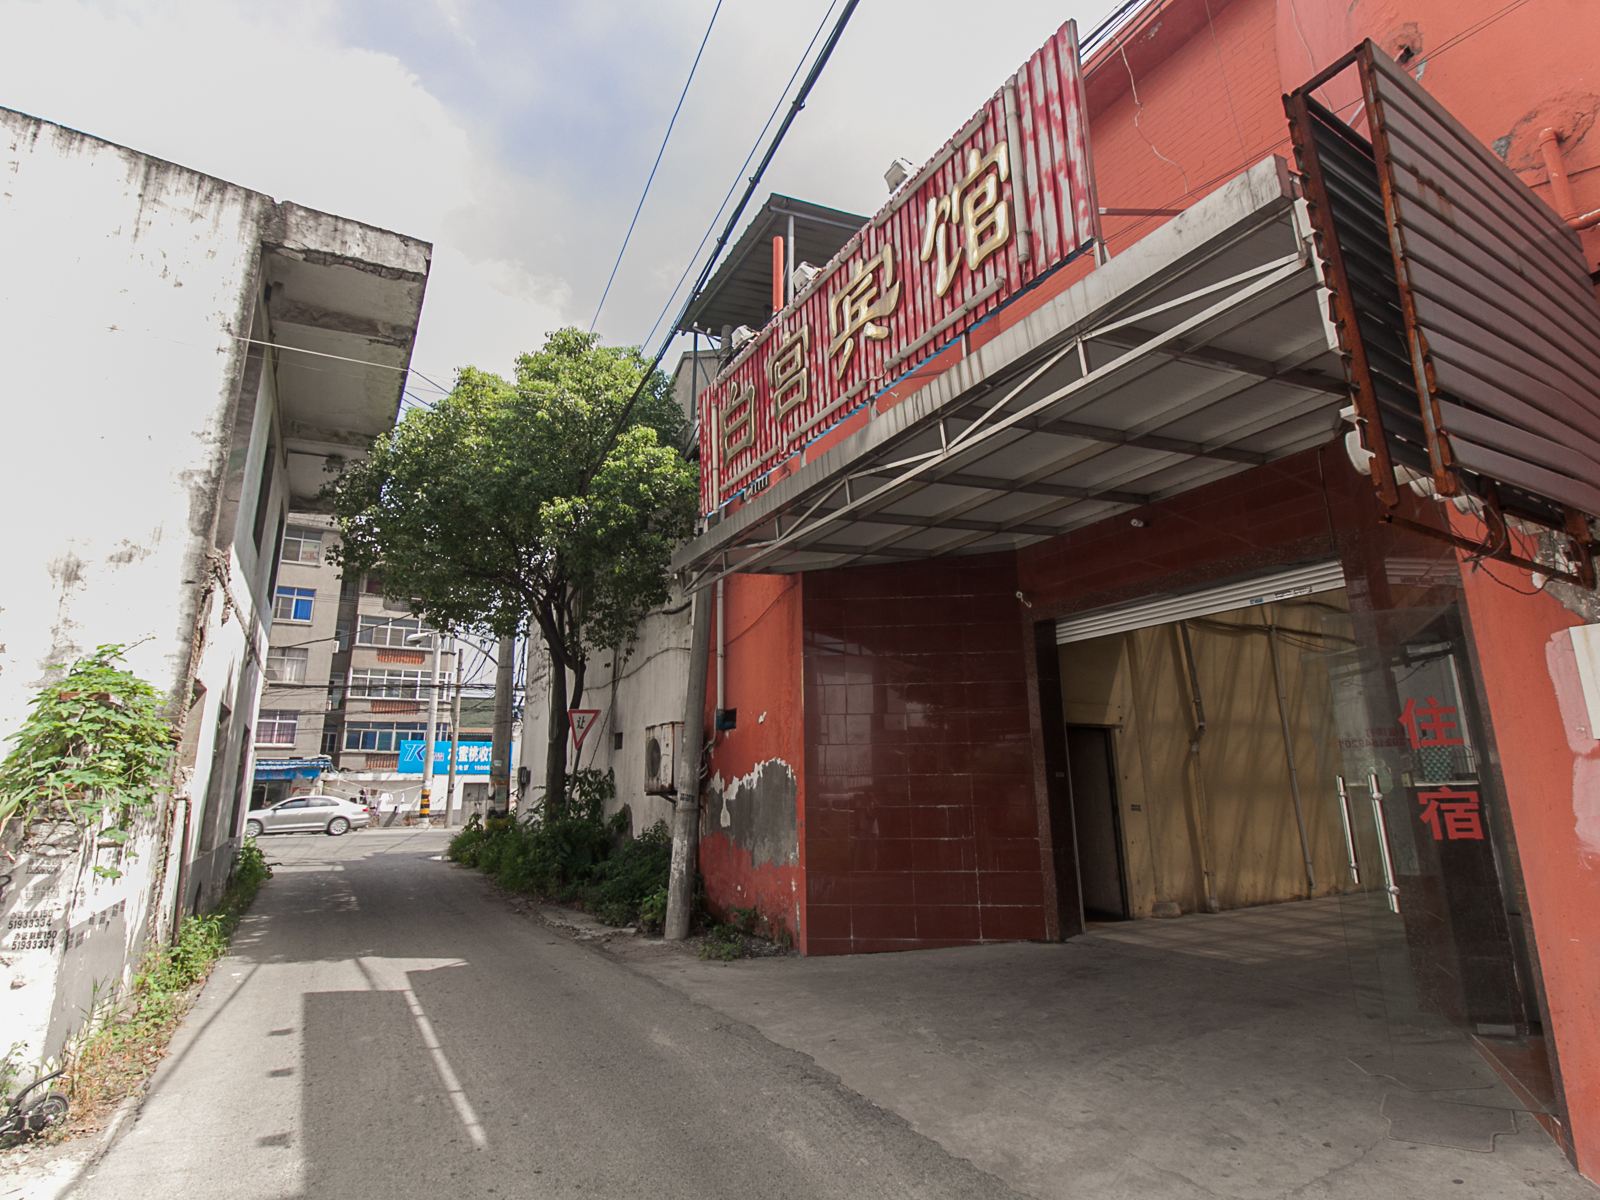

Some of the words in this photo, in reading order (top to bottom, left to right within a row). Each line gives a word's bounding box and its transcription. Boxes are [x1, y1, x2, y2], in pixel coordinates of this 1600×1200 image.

[721, 140, 1010, 469] 白宫宾馆
[576, 715, 585, 730] 让
[1398, 695, 1485, 841] 住宿
[8, 919, 51, 929] 51933334
[12, 940, 54, 950] 51933334
